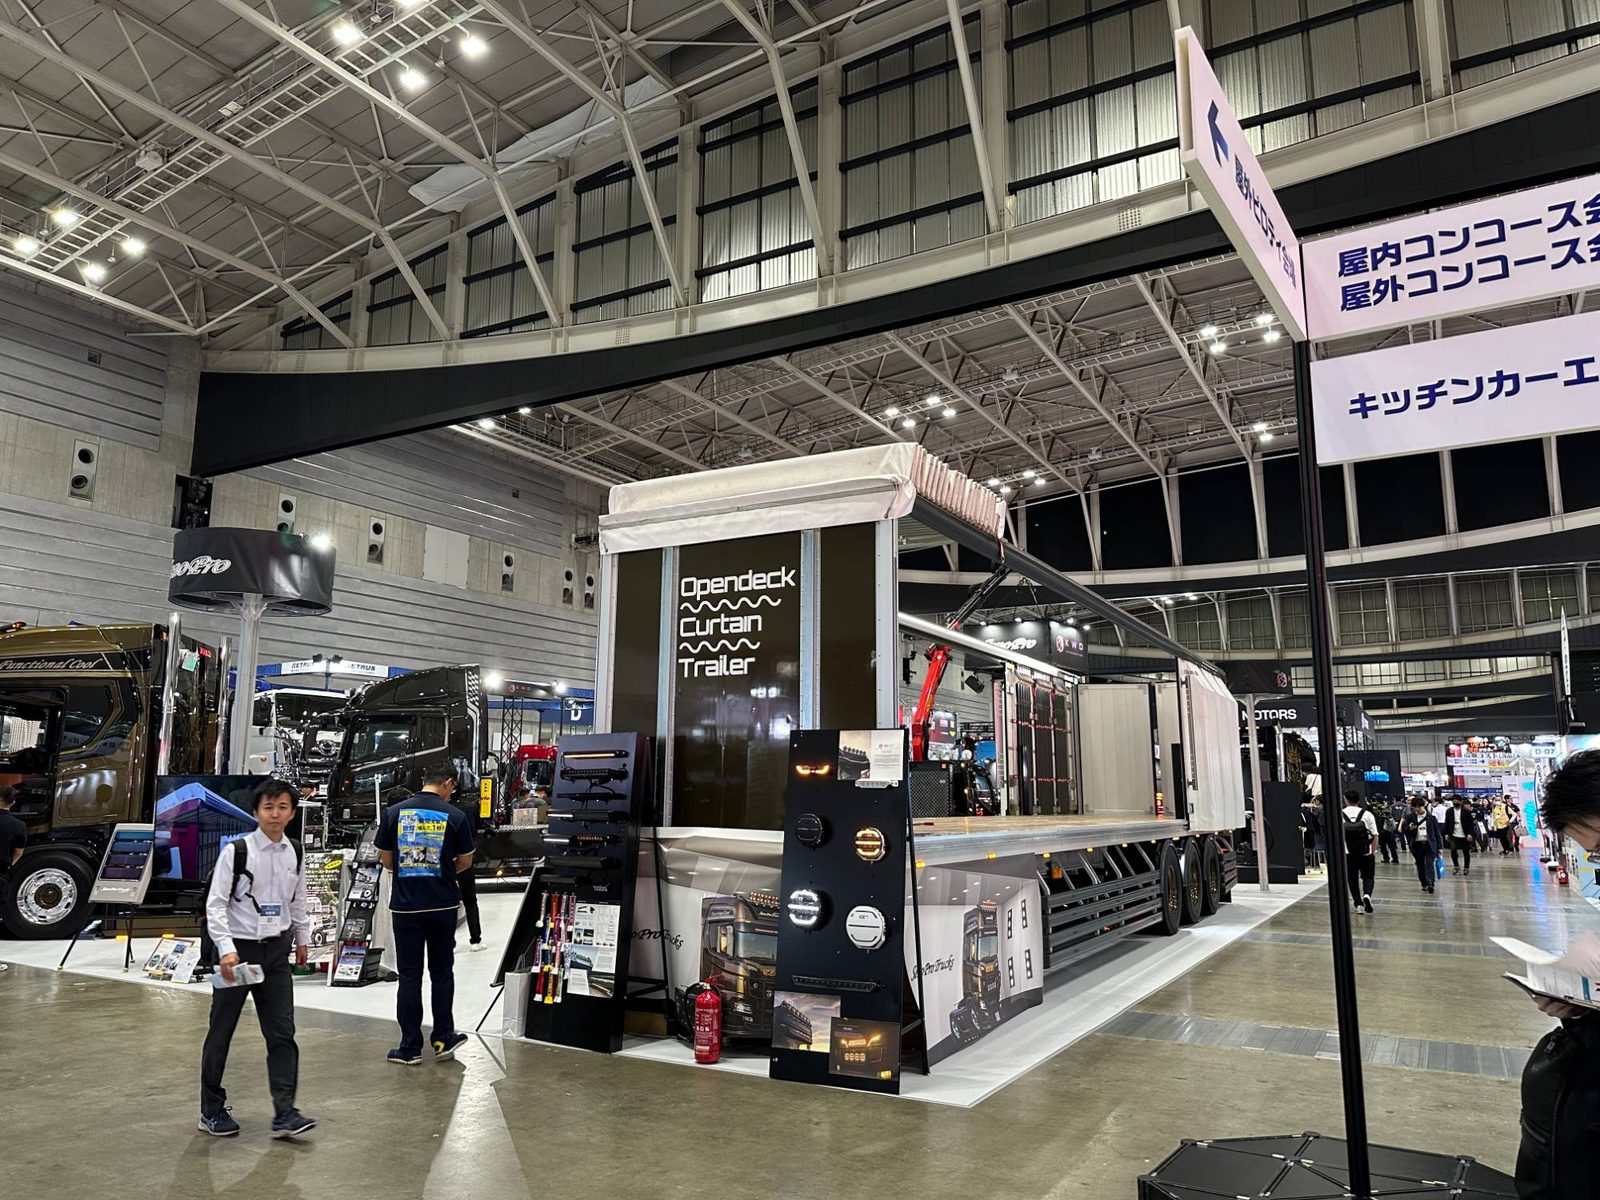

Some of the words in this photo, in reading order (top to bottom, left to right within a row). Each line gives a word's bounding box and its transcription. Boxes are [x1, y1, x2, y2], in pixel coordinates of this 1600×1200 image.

[1349, 356, 1600, 419] キッチンカーエ
[680, 566, 796, 601] Opendeck
[680, 613, 762, 637] Curtain
[0, 659, 75, 670] Functional
[69, 658, 103, 669] Cool
[291, 661, 314, 669] RETRU
[346, 663, 376, 671] ETRUS
[678, 654, 755, 678] Trailer
